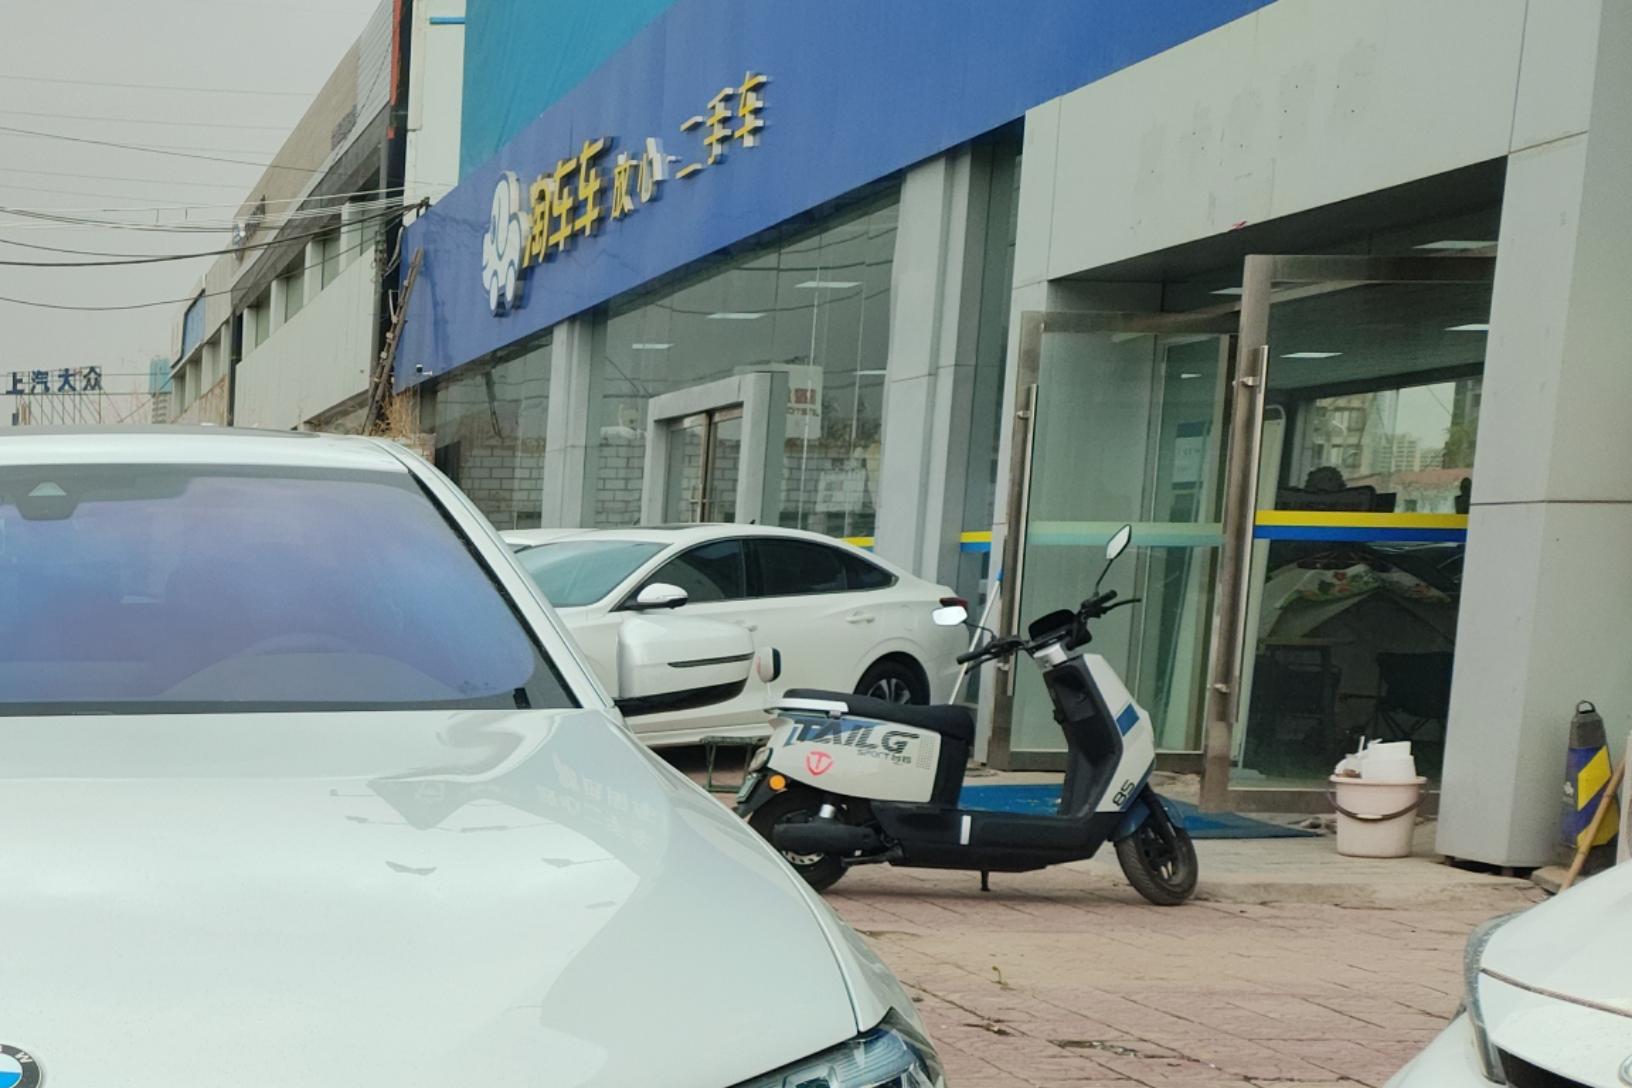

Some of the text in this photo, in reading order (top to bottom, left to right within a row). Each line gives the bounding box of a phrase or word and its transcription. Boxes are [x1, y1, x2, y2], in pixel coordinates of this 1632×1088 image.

[522, 133, 607, 268] 淘车车
[6, 366, 103, 395] 上汽大众
[785, 718, 920, 754] TAILG
